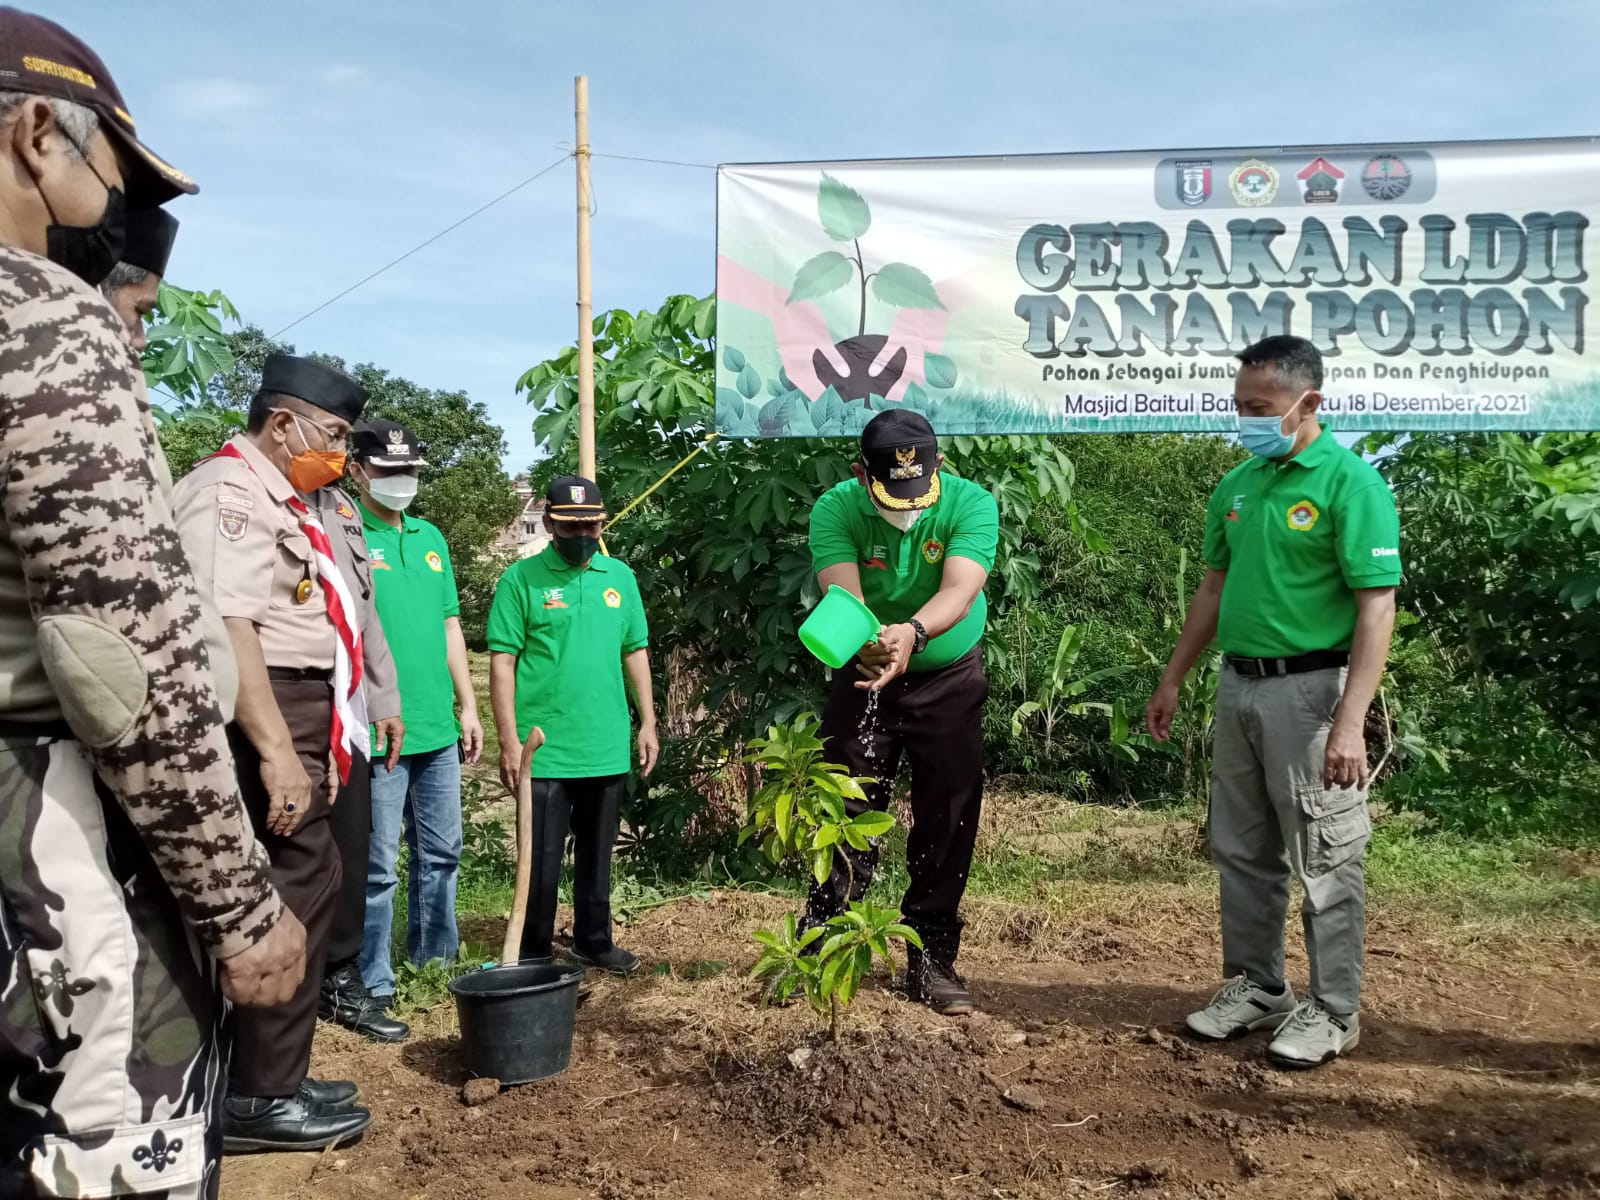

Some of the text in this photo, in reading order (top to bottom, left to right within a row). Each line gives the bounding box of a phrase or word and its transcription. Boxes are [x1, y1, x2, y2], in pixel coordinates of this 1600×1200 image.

[1016, 211, 1590, 292] GERAKAN LDII
[1014, 286, 1590, 358] TANAM POHON
[1042, 364, 1100, 381] Pohon
[1106, 362, 1182, 384] Sebagai
[1188, 362, 1237, 379] Sumb
[1373, 362, 1412, 379] Dan
[1419, 362, 1550, 383] Penghidupan
[1065, 394, 1128, 417] Masjid
[1134, 393, 1194, 413] Baitul
[1201, 392, 1239, 413] Bai
[1349, 394, 1366, 412] 18
[1373, 392, 1475, 413] Desember
[1481, 394, 1527, 412] 2021
